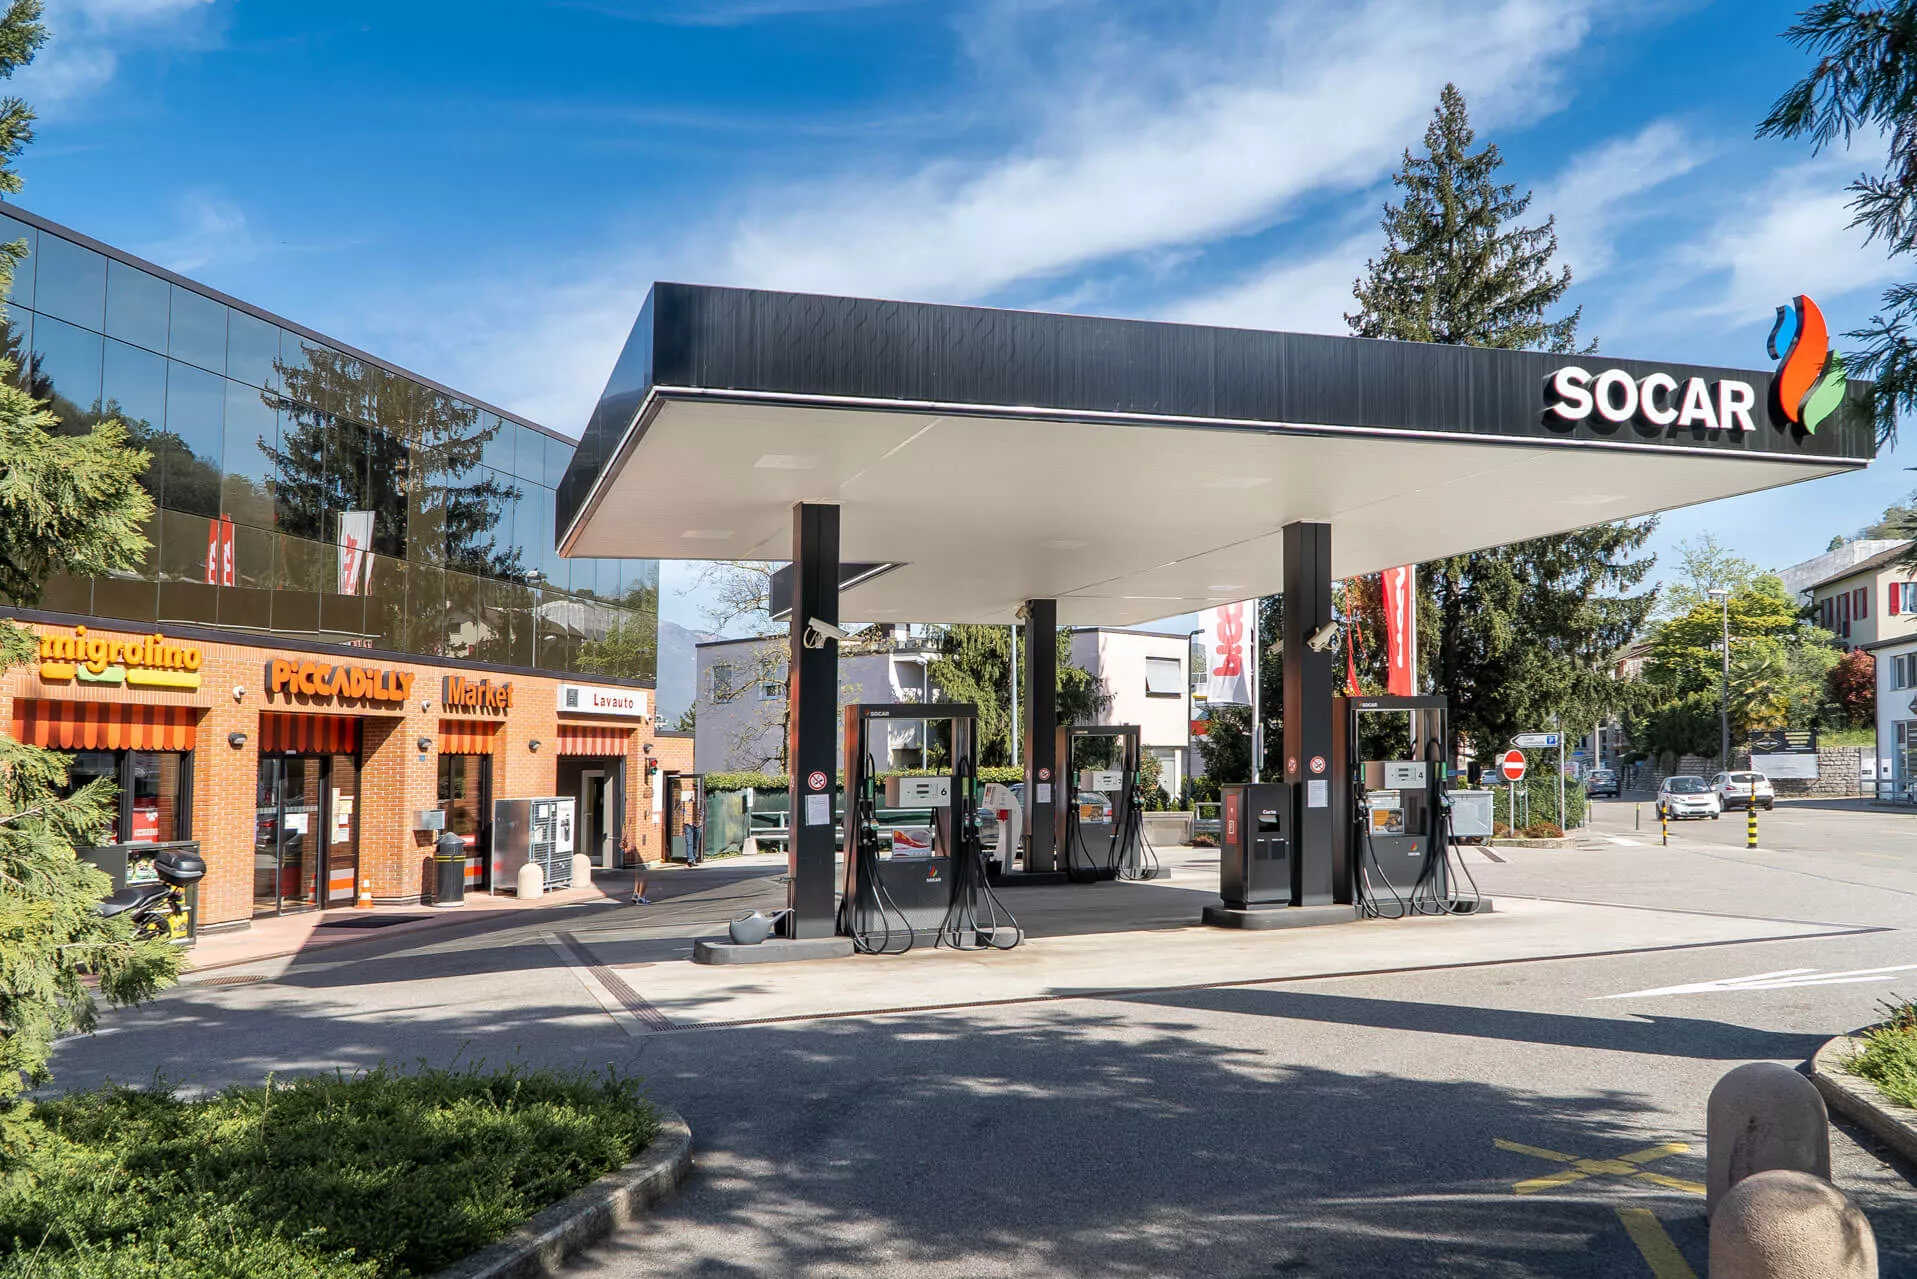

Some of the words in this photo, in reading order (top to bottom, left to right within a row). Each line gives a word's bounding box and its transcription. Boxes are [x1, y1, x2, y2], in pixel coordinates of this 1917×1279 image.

[1550, 365, 1757, 432] SOCAR
[40, 625, 202, 673] migrolino
[446, 675, 514, 709] Market
[593, 692, 634, 709] Lavauto
[940, 787, 947, 796] 6
